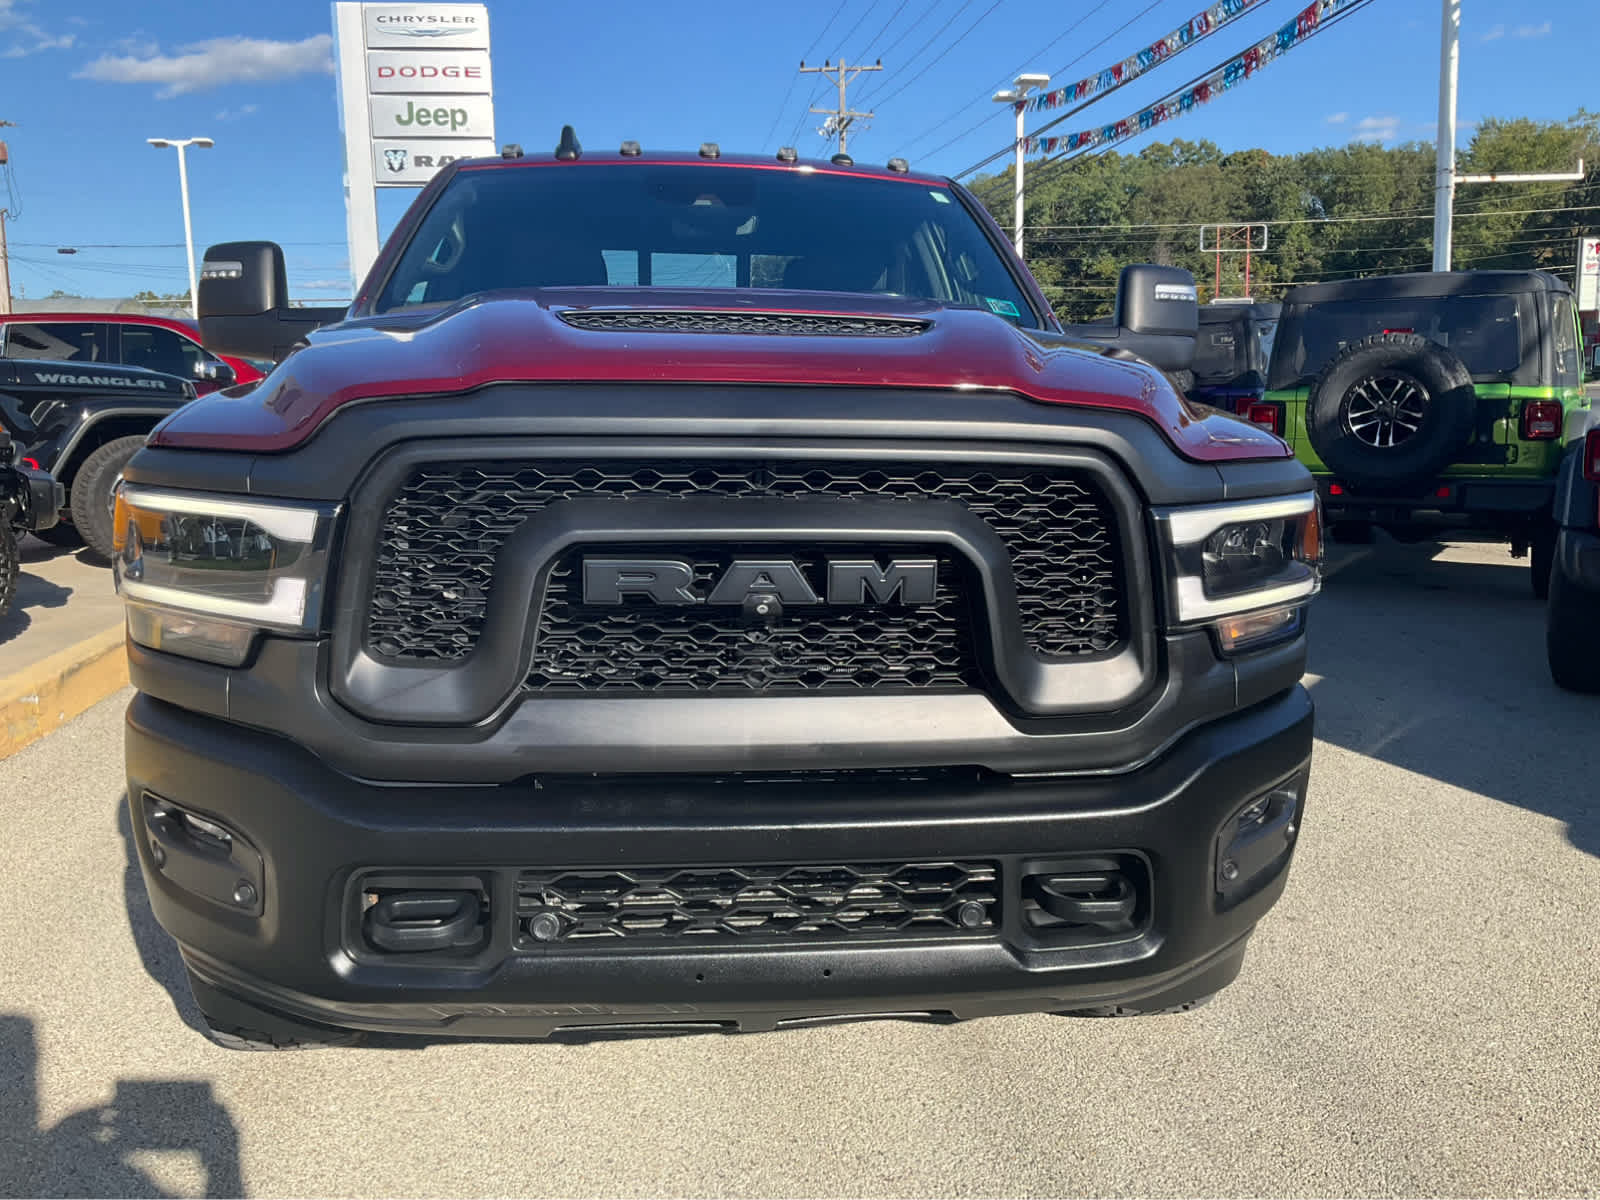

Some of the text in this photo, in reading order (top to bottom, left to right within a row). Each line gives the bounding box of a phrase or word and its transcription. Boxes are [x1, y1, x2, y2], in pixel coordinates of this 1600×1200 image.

[376, 15, 476, 23] CHRYSLER
[377, 66, 481, 78] DODGE
[395, 101, 468, 131] Jeep
[414, 155, 473, 167] RA
[35, 373, 166, 389] WRANGLER
[583, 560, 937, 604] RAM
